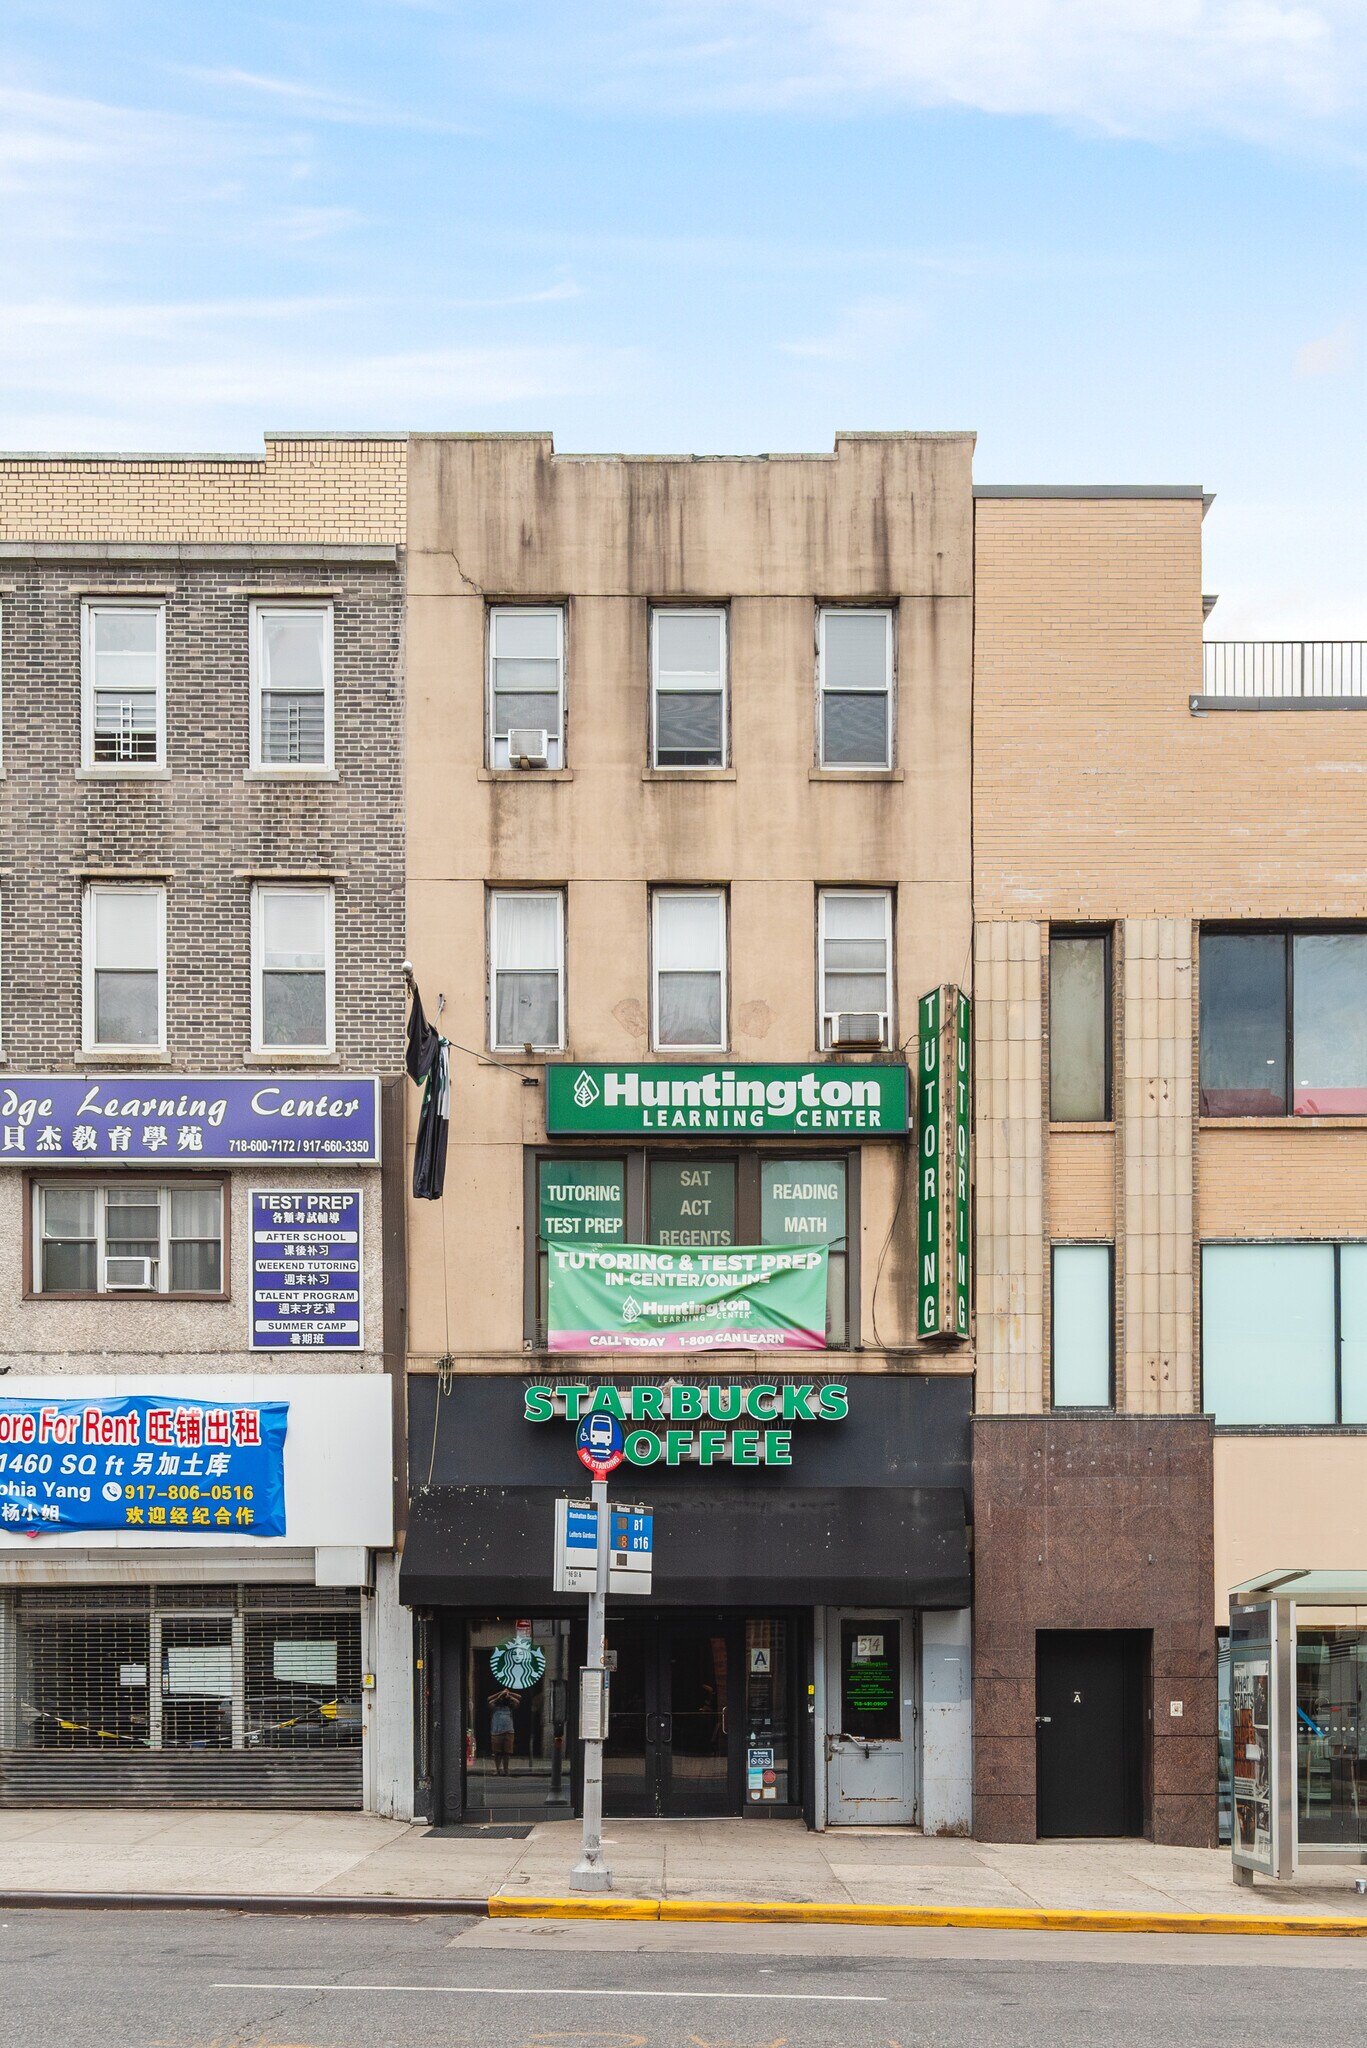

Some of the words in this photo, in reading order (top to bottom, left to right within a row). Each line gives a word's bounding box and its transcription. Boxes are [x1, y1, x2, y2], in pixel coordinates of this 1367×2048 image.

[603, 1071, 881, 1116] Huntington
[76, 1086, 228, 1126] Learning
[250, 1087, 359, 1117] Center
[643, 1110, 764, 1127] LEARNING
[795, 1110, 882, 1127] CENTER
[229, 1139, 296, 1152] 718-600-7172
[296, 1139, 301, 1152] /
[302, 1140, 370, 1153] 917-660-3350
[924, 994, 936, 1329] TUTORING
[957, 994, 966, 1329] TUTORING
[680, 1170, 711, 1187] SAT
[547, 1185, 621, 1201] TUTORING
[772, 1184, 838, 1200] READING
[258, 1195, 303, 1210] TEST
[307, 1195, 354, 1210] PREP
[680, 1200, 711, 1216] ACT
[545, 1218, 581, 1234] TEST
[584, 1218, 623, 1234] PREP
[784, 1216, 827, 1233] MATH
[266, 1233, 300, 1241] AFTER
[303, 1233, 347, 1241] SCHOOL
[659, 1230, 731, 1246] REGENTS
[258, 1262, 305, 1270] WEEKEND
[308, 1262, 357, 1270] TUTORING
[554, 1251, 673, 1271] TUTORING
[678, 1254, 694, 1271] &
[701, 1254, 760, 1271] TEST
[761, 1252, 822, 1271] PREP
[605, 1272, 771, 1288] IN-CENTER/ONLINE
[259, 1292, 300, 1300] TALENT
[303, 1292, 355, 1300] PROGRAM
[643, 1299, 750, 1318] Huntington
[268, 1322, 314, 1330] SUMMER
[316, 1322, 347, 1330] CAMP
[657, 1315, 706, 1323] LEARNING
[589, 1335, 621, 1347] CALL
[623, 1336, 666, 1348] TODAY
[679, 1334, 714, 1346] 1-800
[715, 1332, 742, 1344] CAN
[743, 1333, 785, 1344] LEARN
[523, 1384, 849, 1422] STARBUCKS
[39, 1406, 81, 1444] For
[83, 1407, 140, 1445] Rent
[146, 1407, 262, 1447] 旺铺出租
[624, 1429, 792, 1466] OFFEE
[0, 1453, 53, 1474] 1460
[60, 1454, 97, 1475] SQ
[104, 1453, 125, 1476] ft
[132, 1451, 232, 1477] 另加土库
[581, 1452, 591, 1464] NO
[591, 1456, 620, 1470] STANDING
[42, 1482, 91, 1502] Yang
[125, 1485, 254, 1500] 917-806-0516
[1, 1503, 62, 1523] 杨小姐
[126, 1506, 255, 1526] 欢迎经纪合作
[633, 1517, 644, 1532] B1
[633, 1536, 649, 1550] B16
[859, 1638, 881, 1653] 514
[754, 1650, 767, 1666] A
[1073, 1694, 1081, 1703] A
